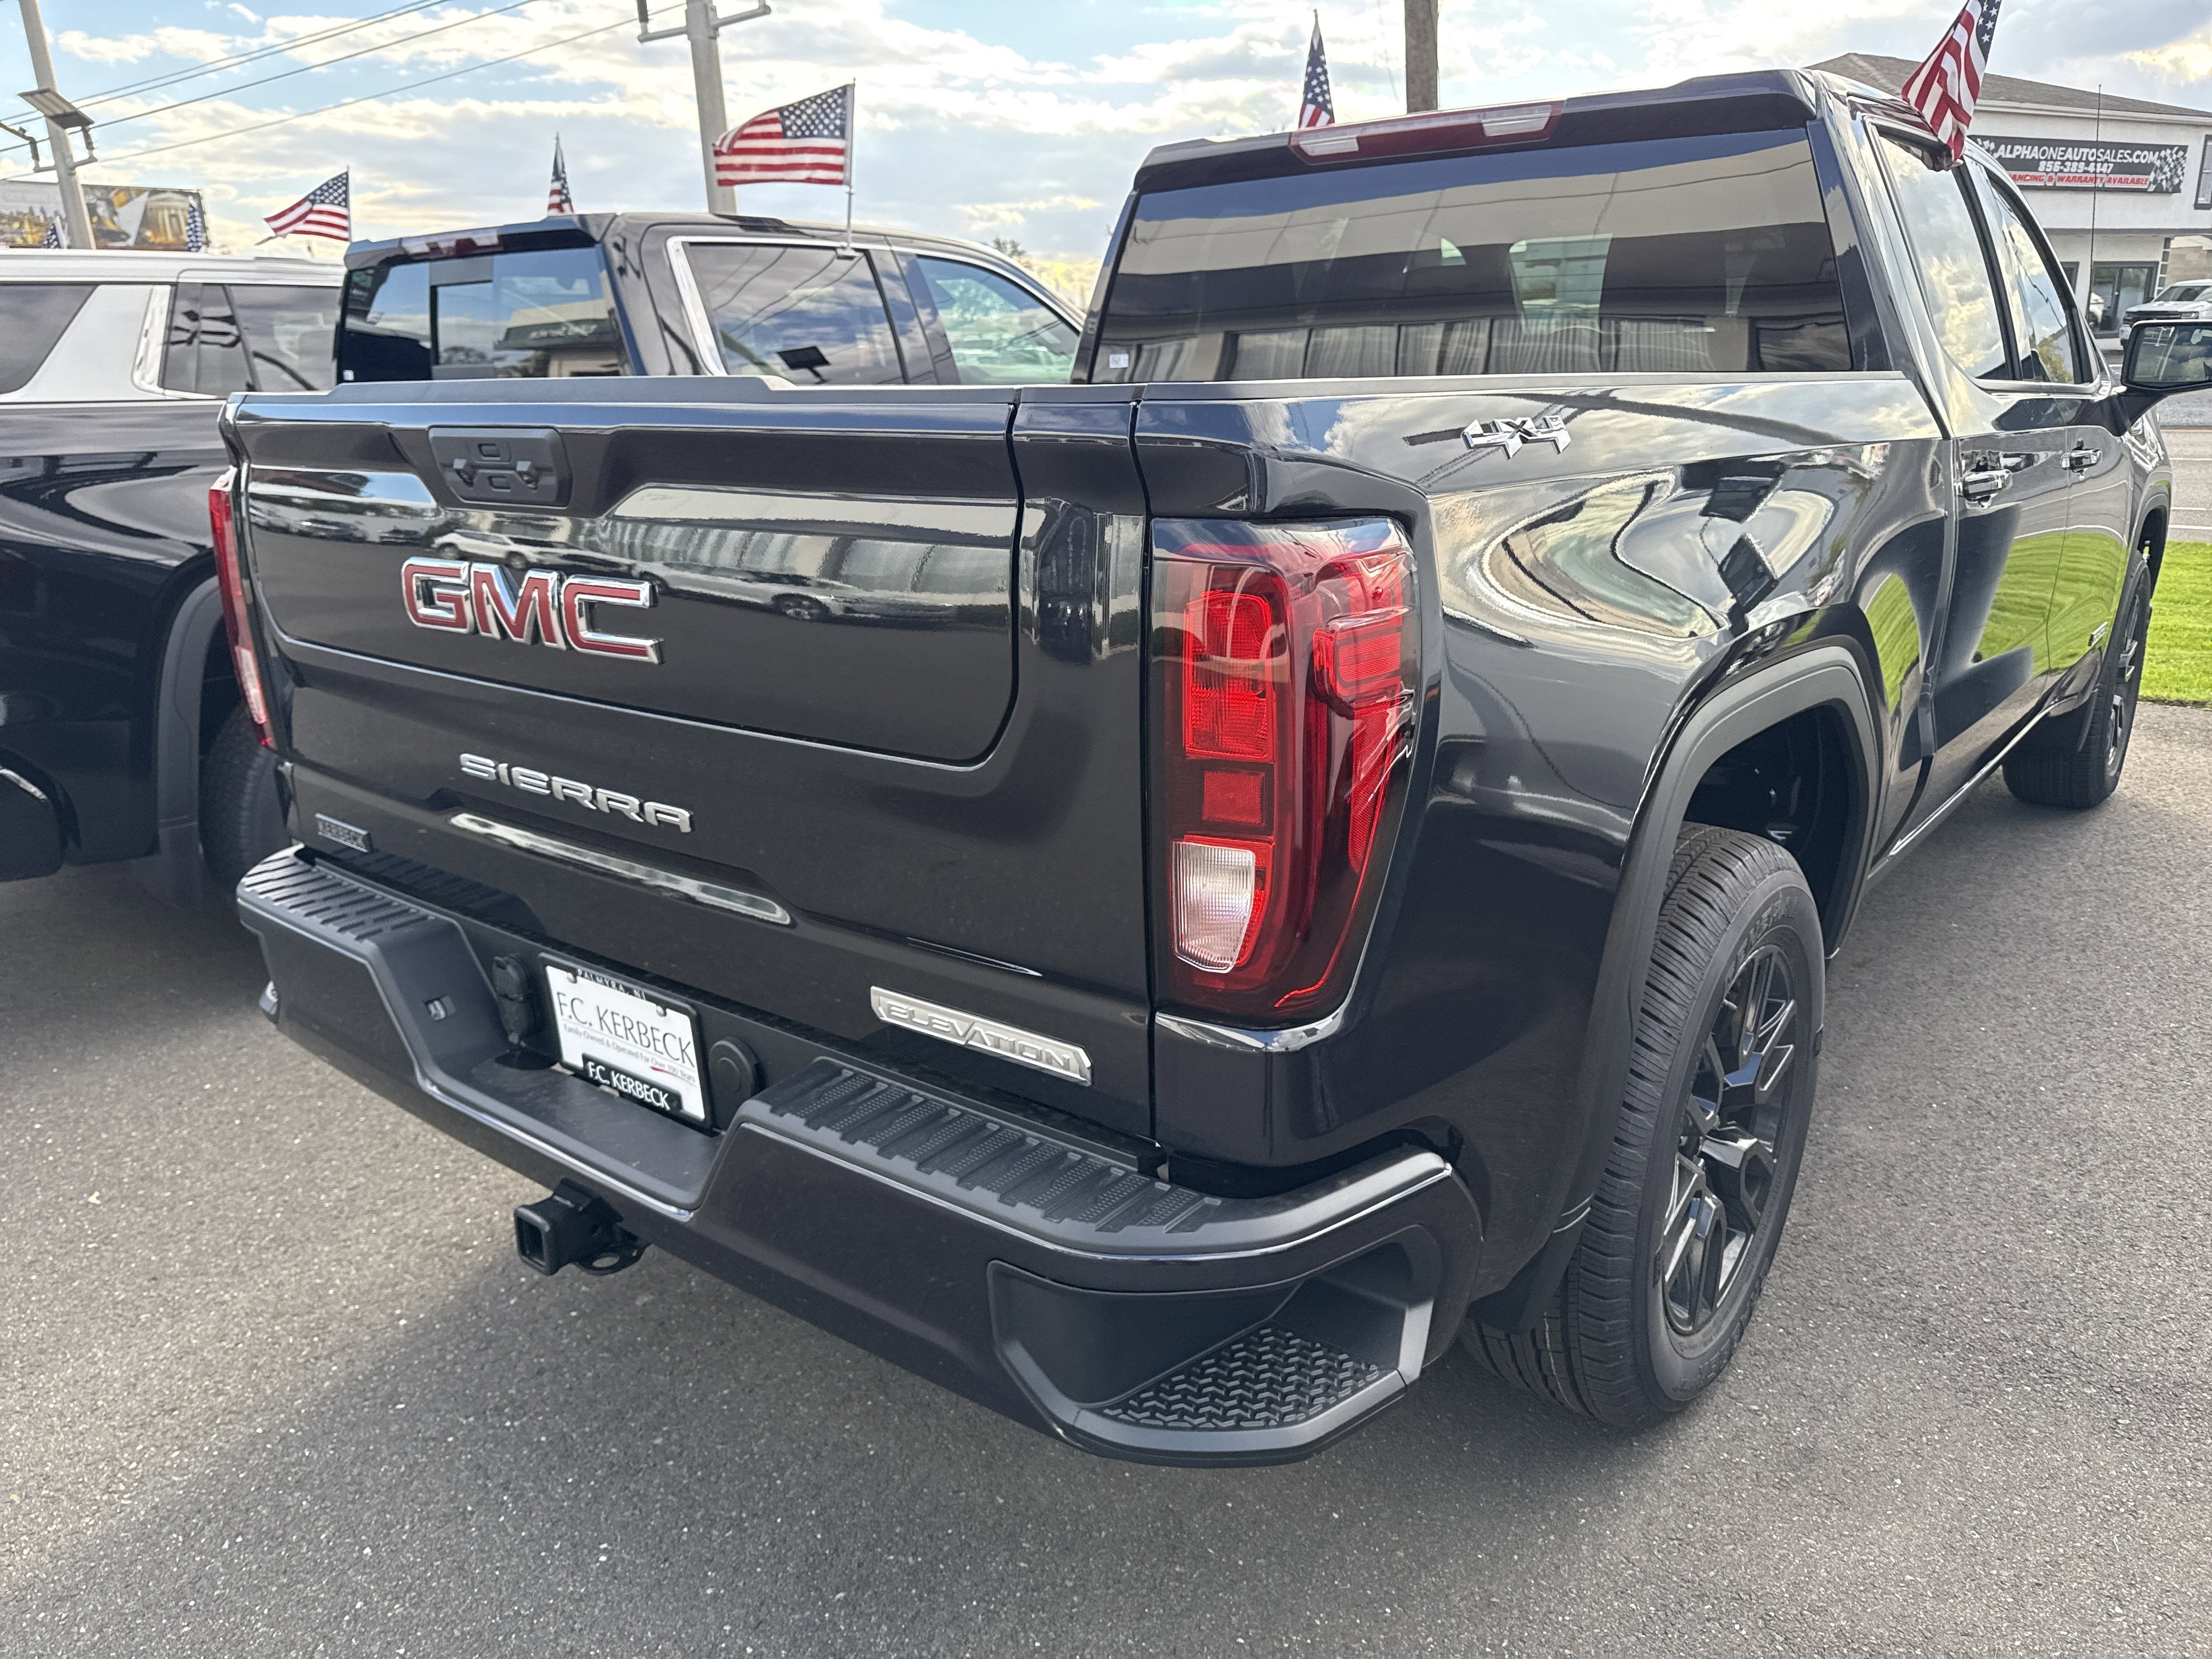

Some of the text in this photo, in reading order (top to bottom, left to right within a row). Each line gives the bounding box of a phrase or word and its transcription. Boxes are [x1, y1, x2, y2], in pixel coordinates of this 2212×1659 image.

[1994, 144, 2159, 164] ALPHAONEAUTOSALES.COM
[2010, 173, 2045, 183] ANCING
[2057, 175, 2105, 184] WARRANTY
[2107, 177, 2150, 185] AVAILABLE
[402, 556, 664, 664] GMC
[460, 753, 693, 833] SIERRA
[556, 991, 696, 1069] F.C. KERBECK
[564, 1023, 583, 1037] Family
[640, 1052, 650, 1063] For
[651, 1058, 666, 1069] Over
[680, 1070, 696, 1083] Years
[886, 1000, 1070, 1070] ELEVATION
[588, 1062, 671, 1111] F.C. KERBECK
